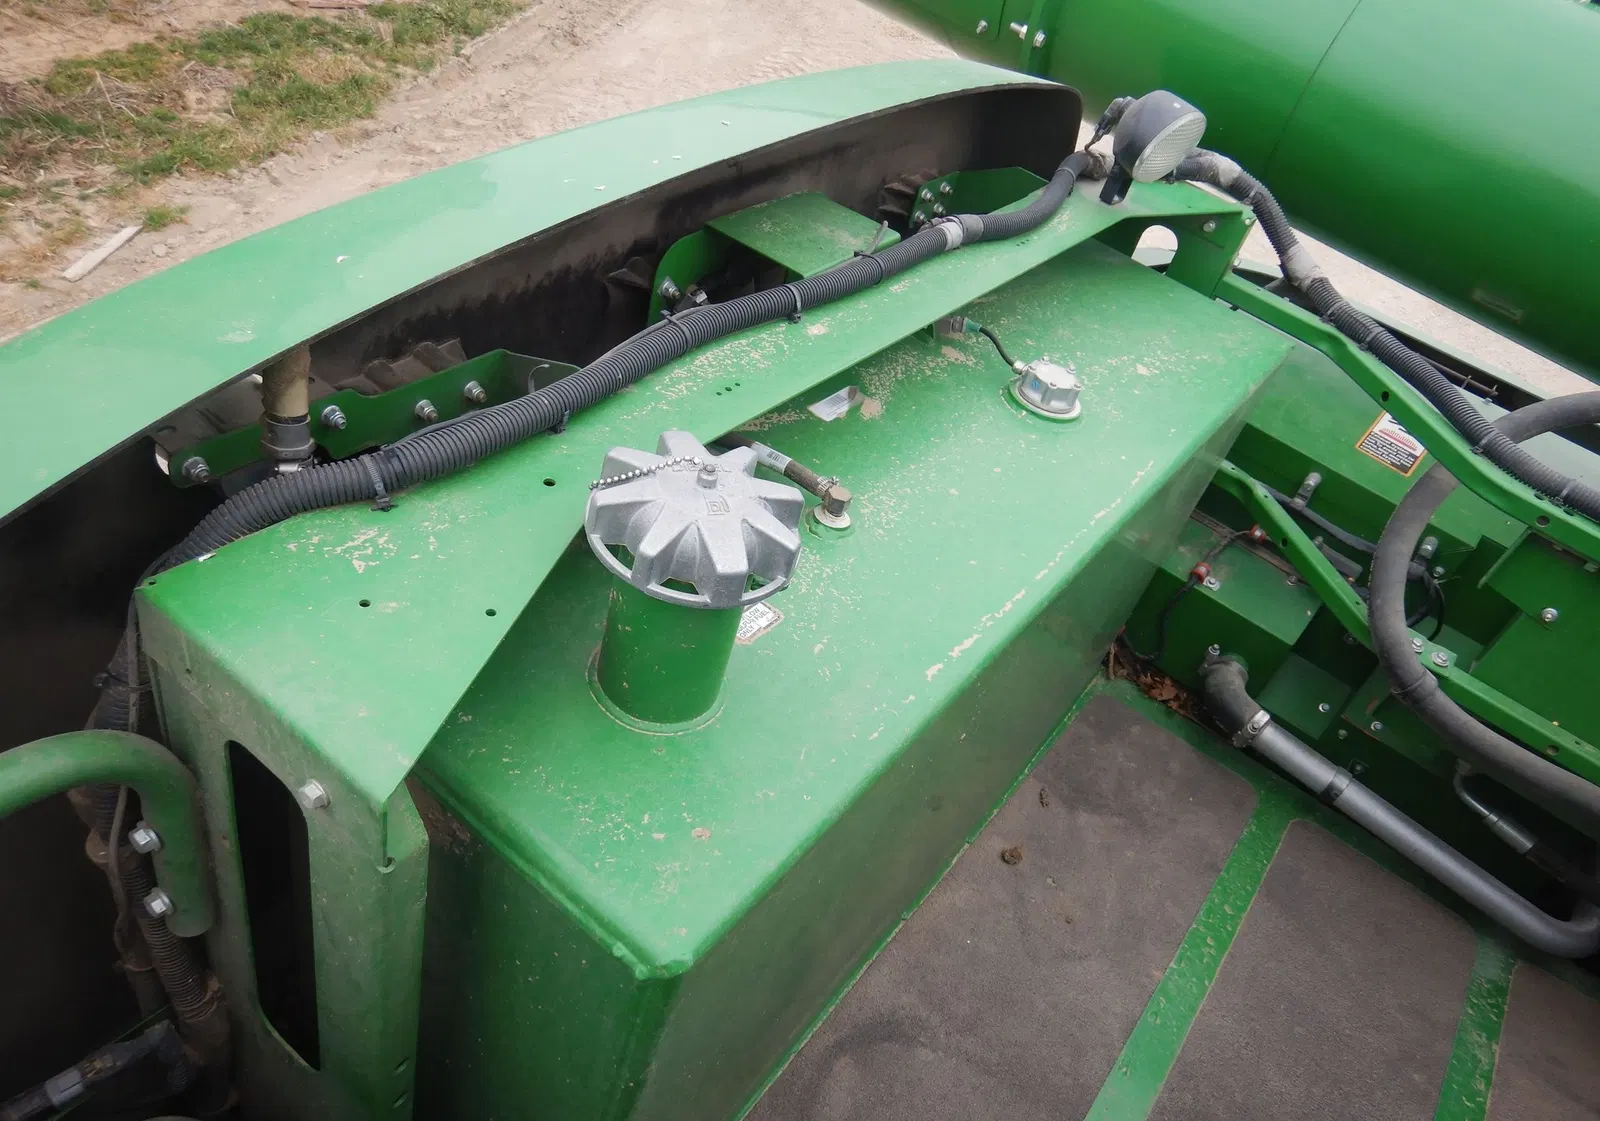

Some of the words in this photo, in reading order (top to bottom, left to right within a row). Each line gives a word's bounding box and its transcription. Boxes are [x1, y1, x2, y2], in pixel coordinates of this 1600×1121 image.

[672, 462, 732, 473] DIEEL
[754, 610, 770, 621] FUEL
[739, 625, 754, 638] ONLY
